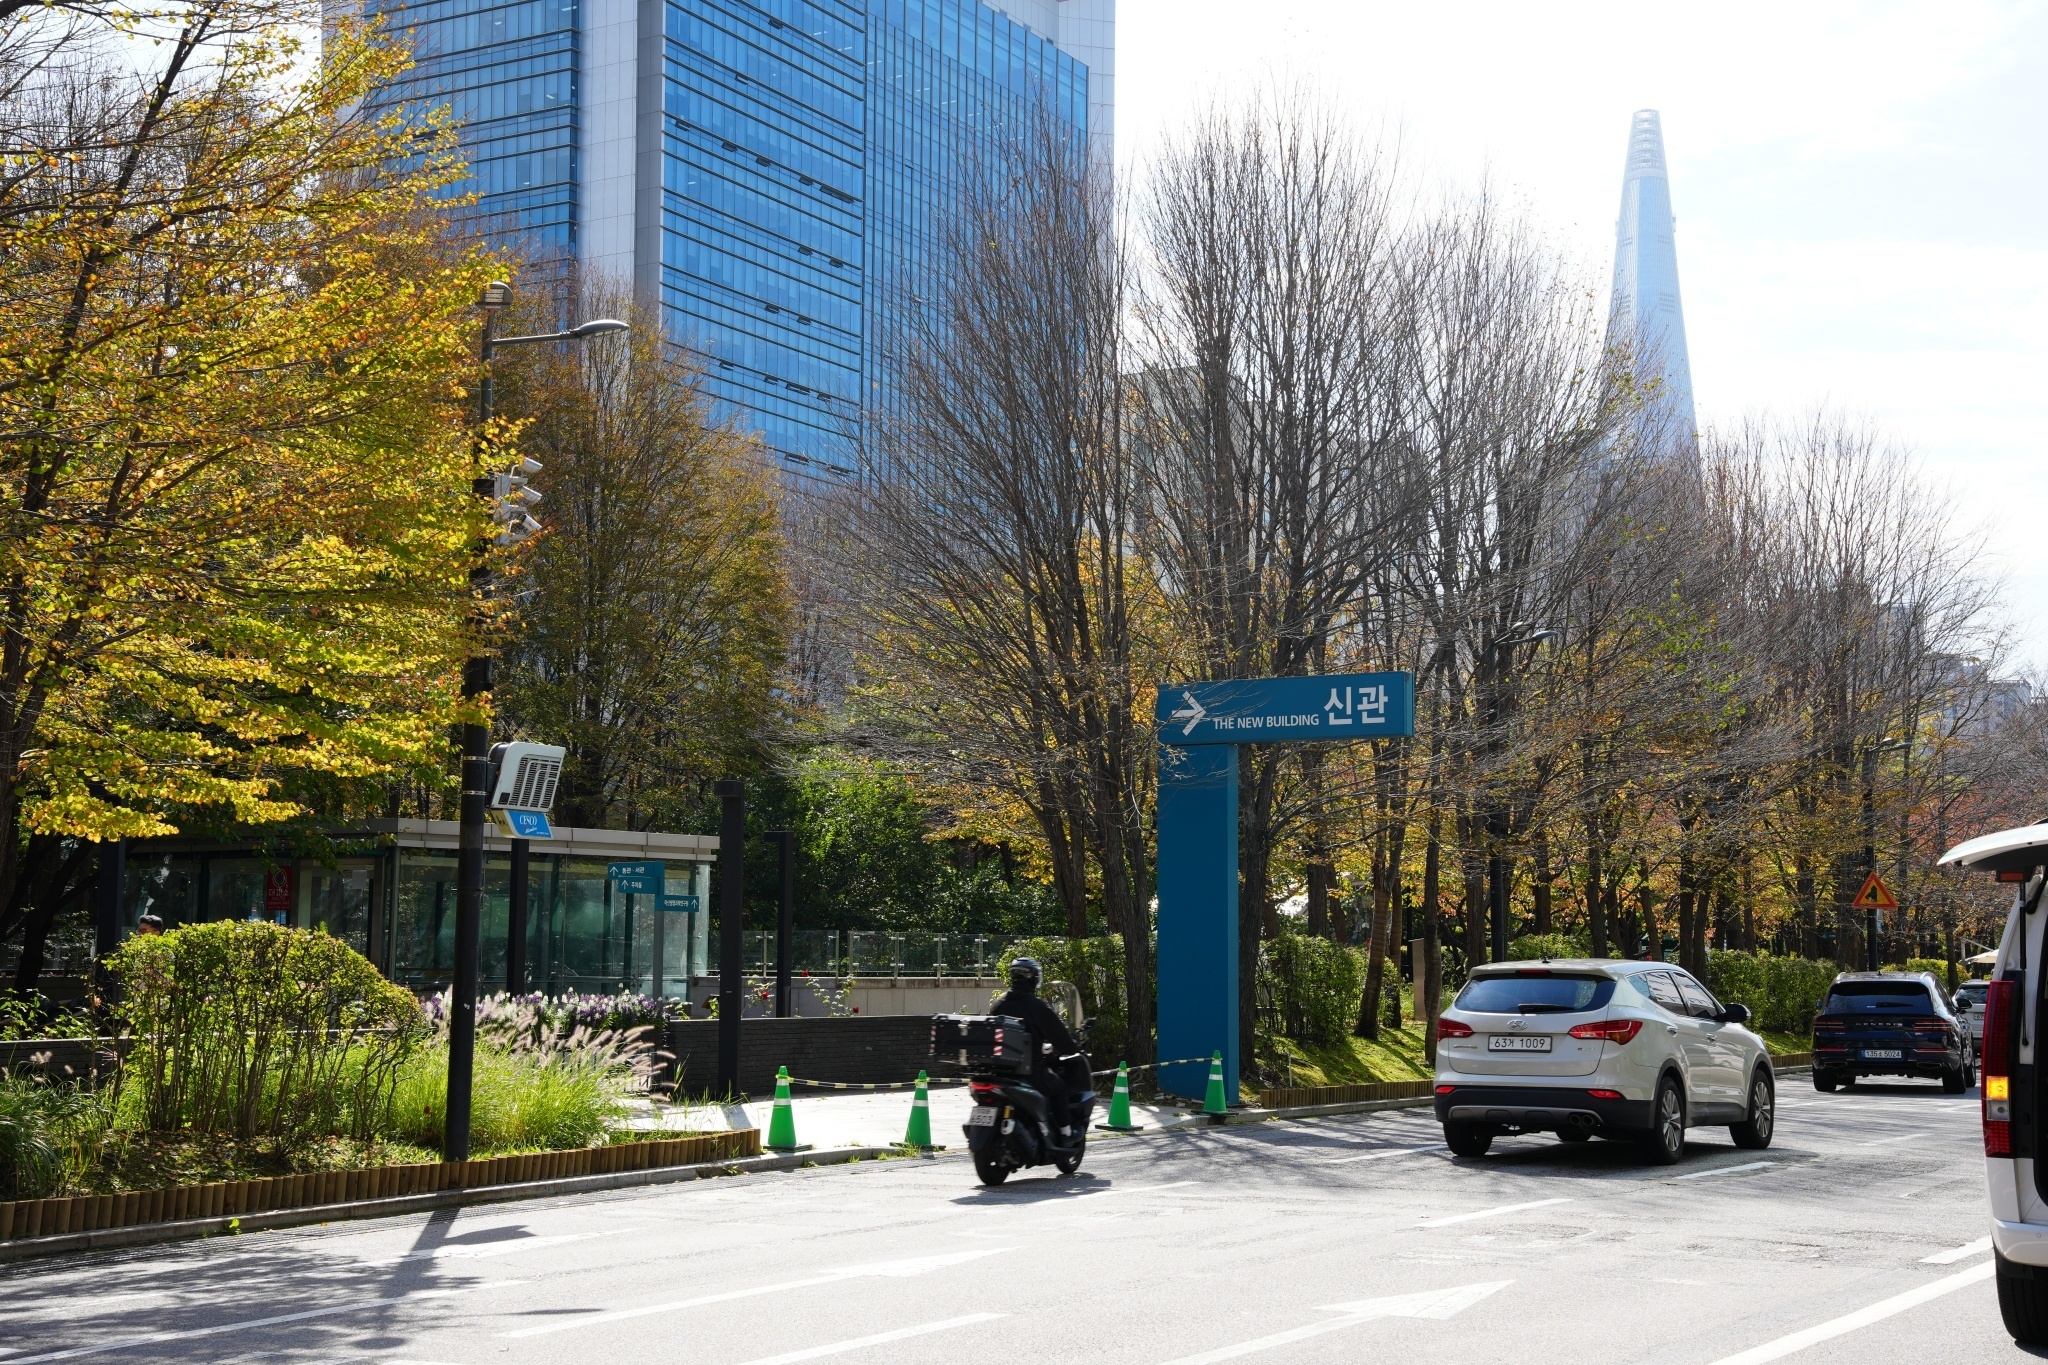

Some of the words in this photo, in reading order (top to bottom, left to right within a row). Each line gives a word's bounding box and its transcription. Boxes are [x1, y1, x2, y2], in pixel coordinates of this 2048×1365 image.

[1323, 684, 1389, 726] 신관
[1212, 717, 1235, 730] THE
[1237, 716, 1264, 729] NEW
[1266, 713, 1320, 728] BUILDING
[519, 814, 538, 826] CESCO
[268, 888, 289, 897] 대피소
[1494, 1037, 1515, 1048] 63거
[1519, 1038, 1546, 1048] 1009
[1884, 1050, 1900, 1058] 5024
